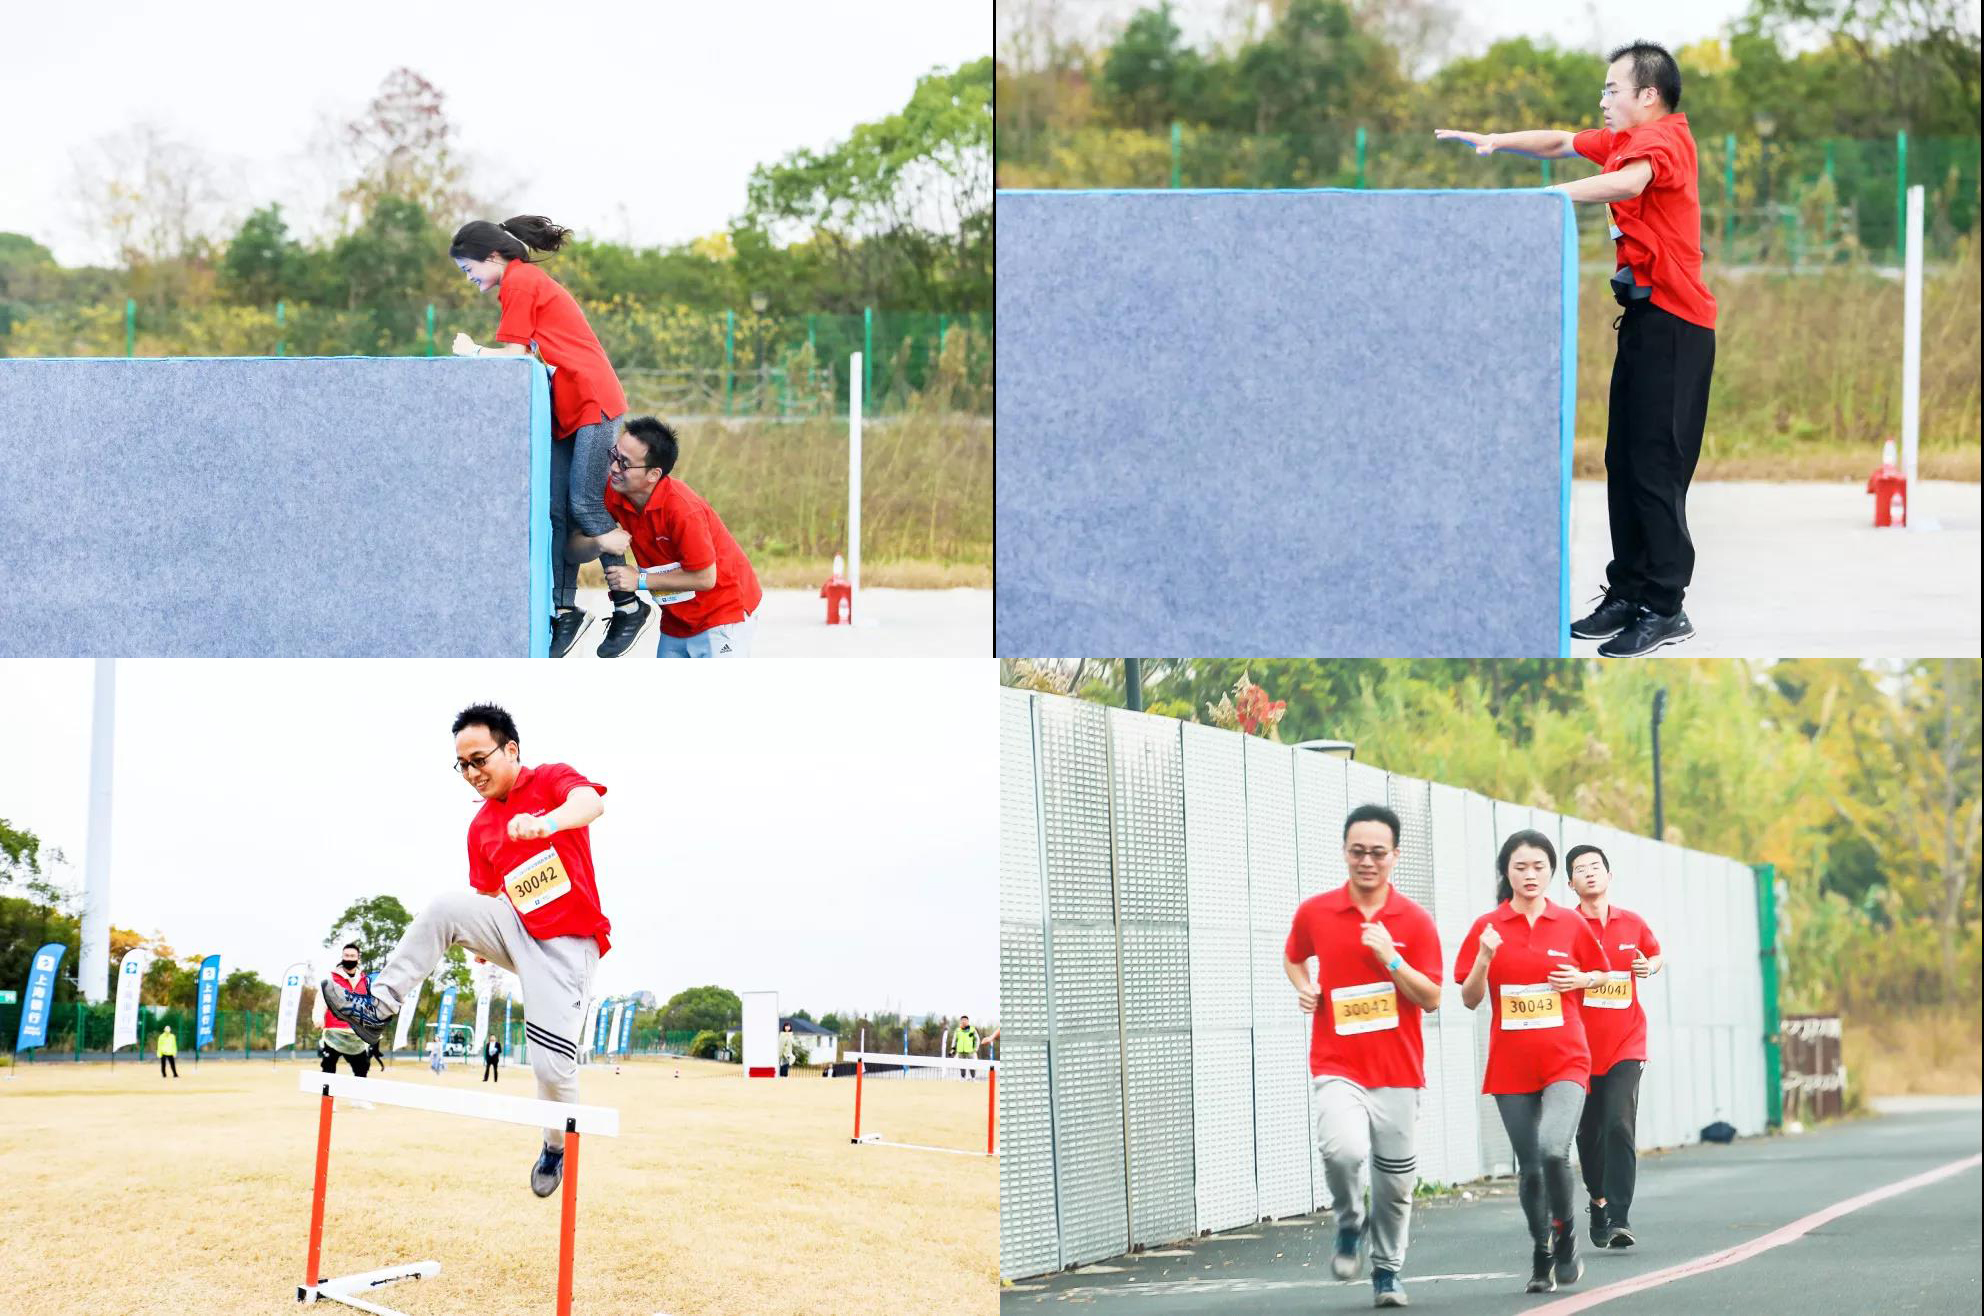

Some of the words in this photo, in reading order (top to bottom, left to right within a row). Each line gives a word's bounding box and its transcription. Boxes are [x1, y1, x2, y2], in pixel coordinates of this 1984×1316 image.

[515, 866, 558, 898] 30042
[1343, 999, 1390, 1017] 30042
[1510, 998, 1553, 1014] 30043
